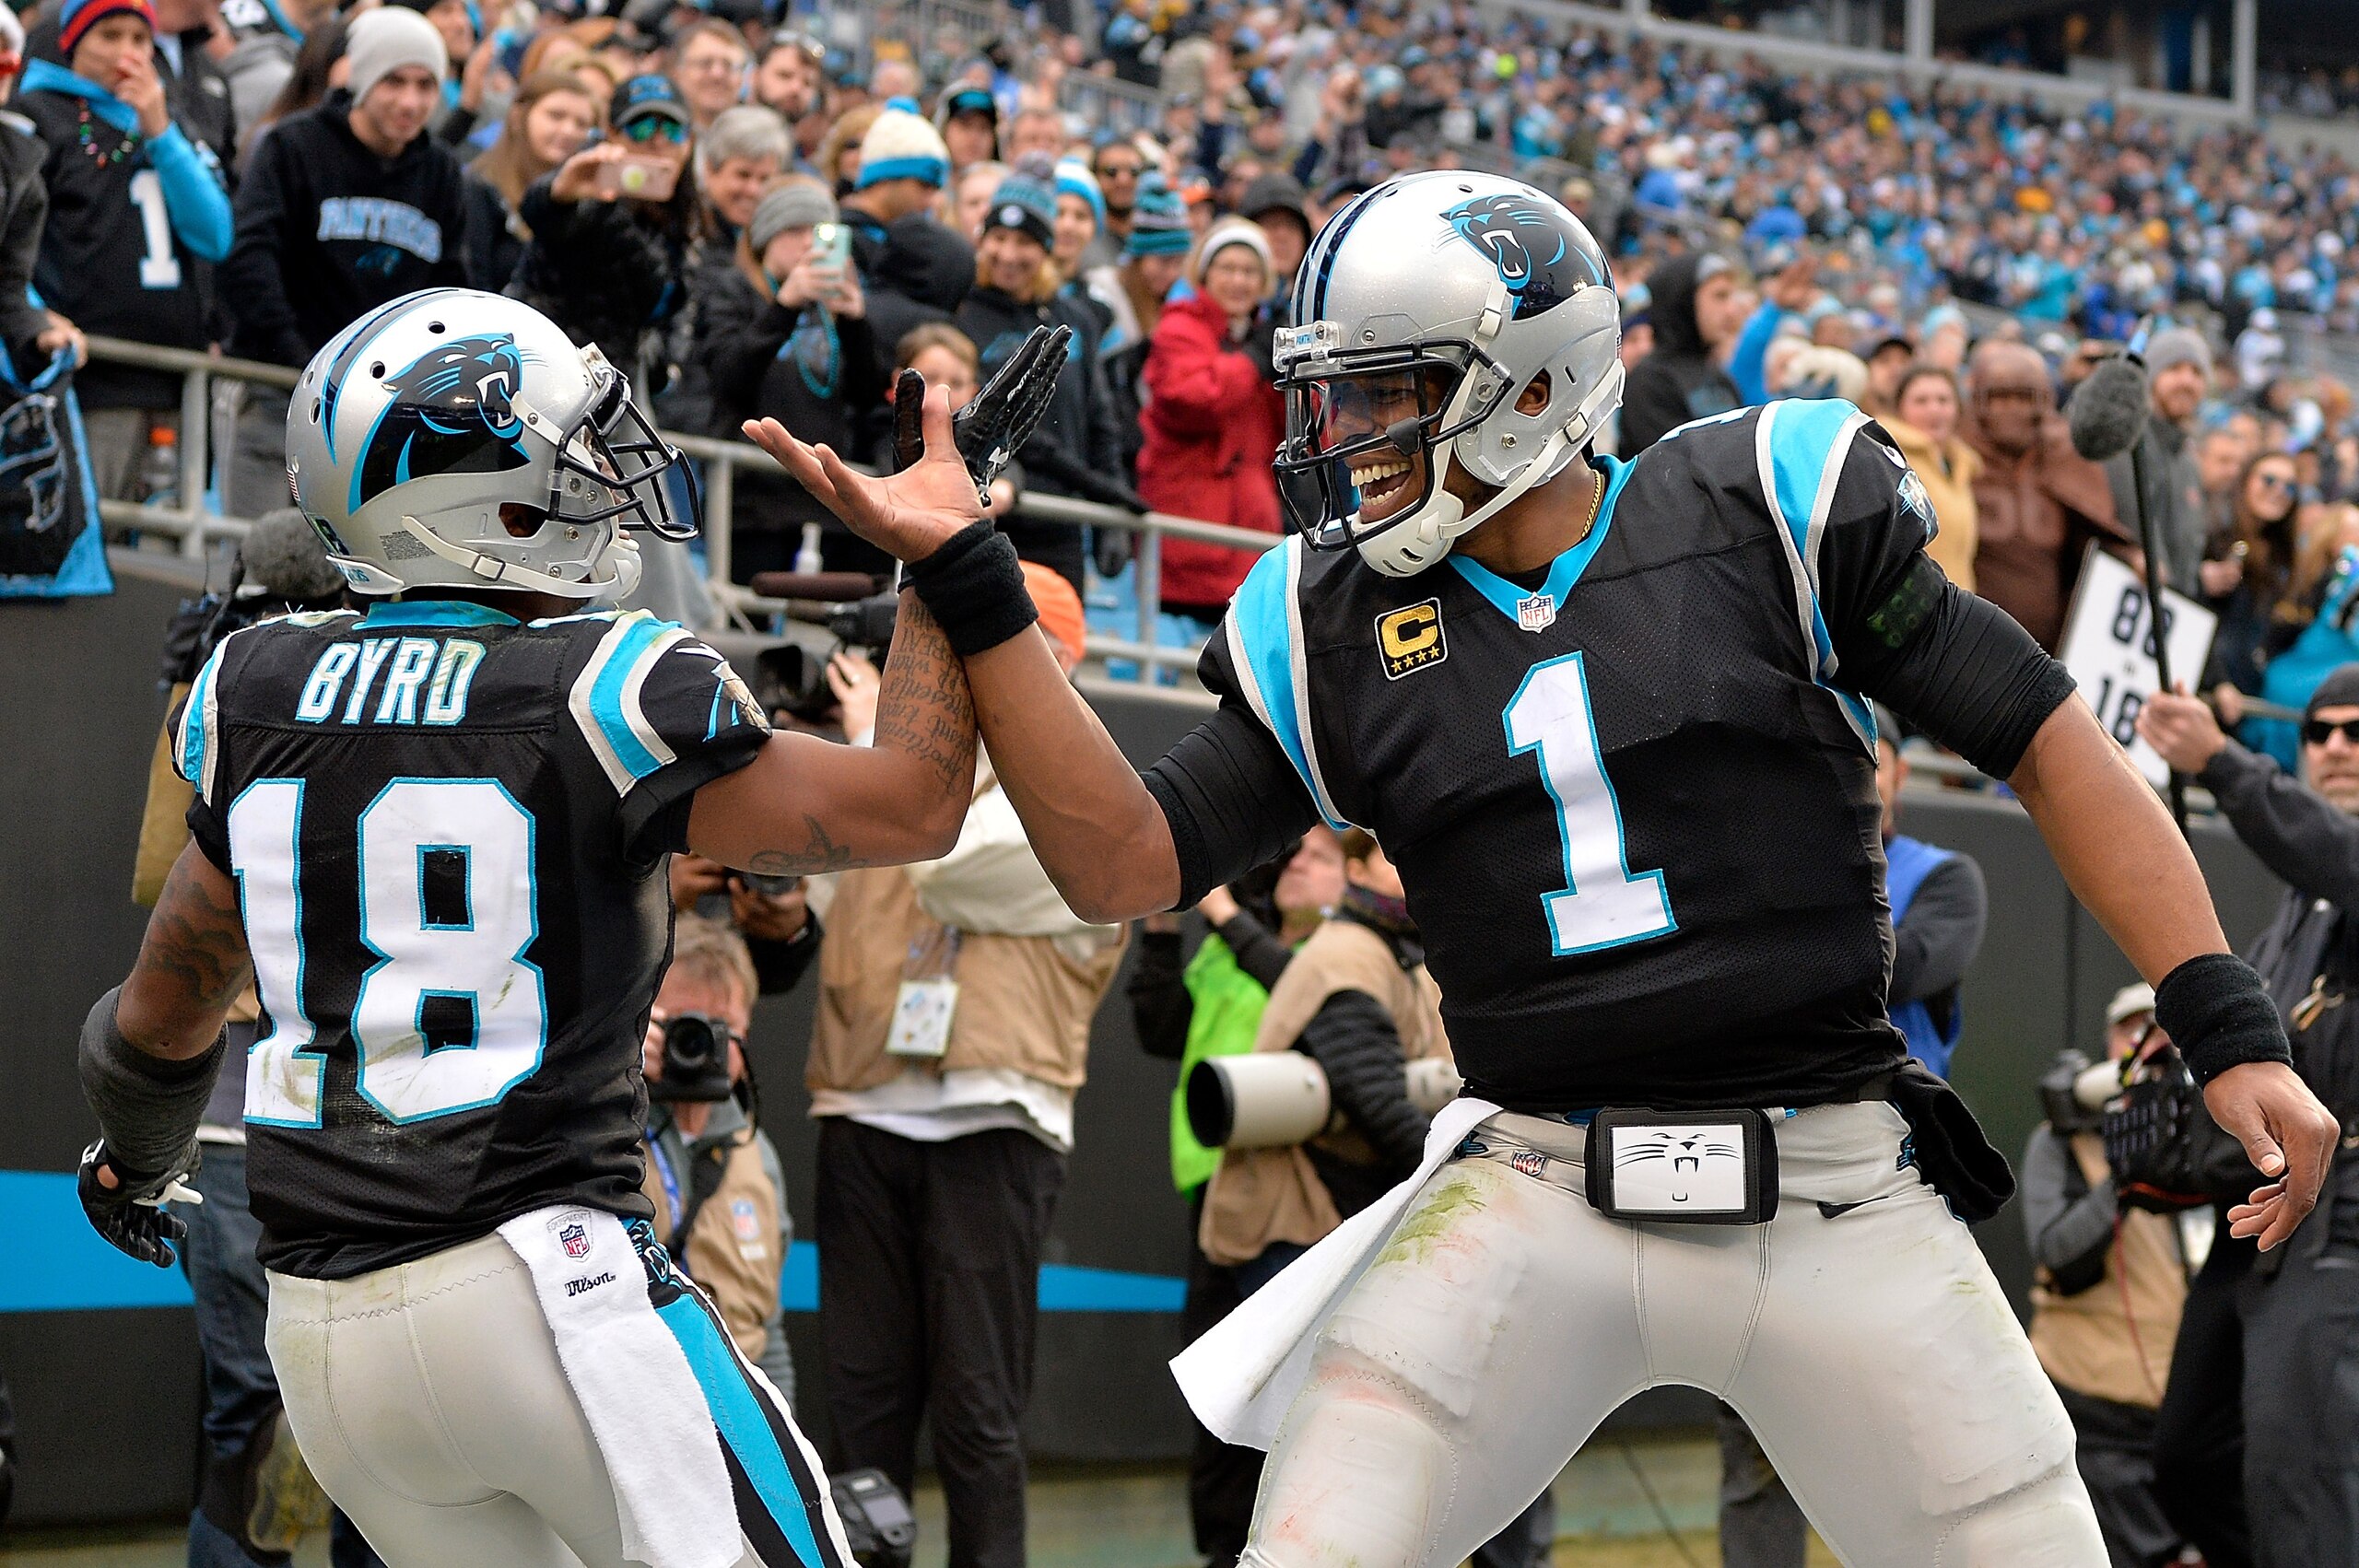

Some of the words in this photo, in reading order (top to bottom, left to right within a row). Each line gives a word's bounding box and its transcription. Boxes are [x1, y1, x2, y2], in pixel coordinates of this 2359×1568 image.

[129, 169, 182, 289] 1
[1381, 604, 1438, 659] C
[1523, 607, 1550, 625] NFL
[295, 636, 487, 726] BYRD
[2094, 678, 2143, 747] 18
[1502, 650, 1679, 956] 1
[227, 776, 548, 1129] 18
[565, 1237, 588, 1255] NFL
[564, 1271, 611, 1297] Wilson
